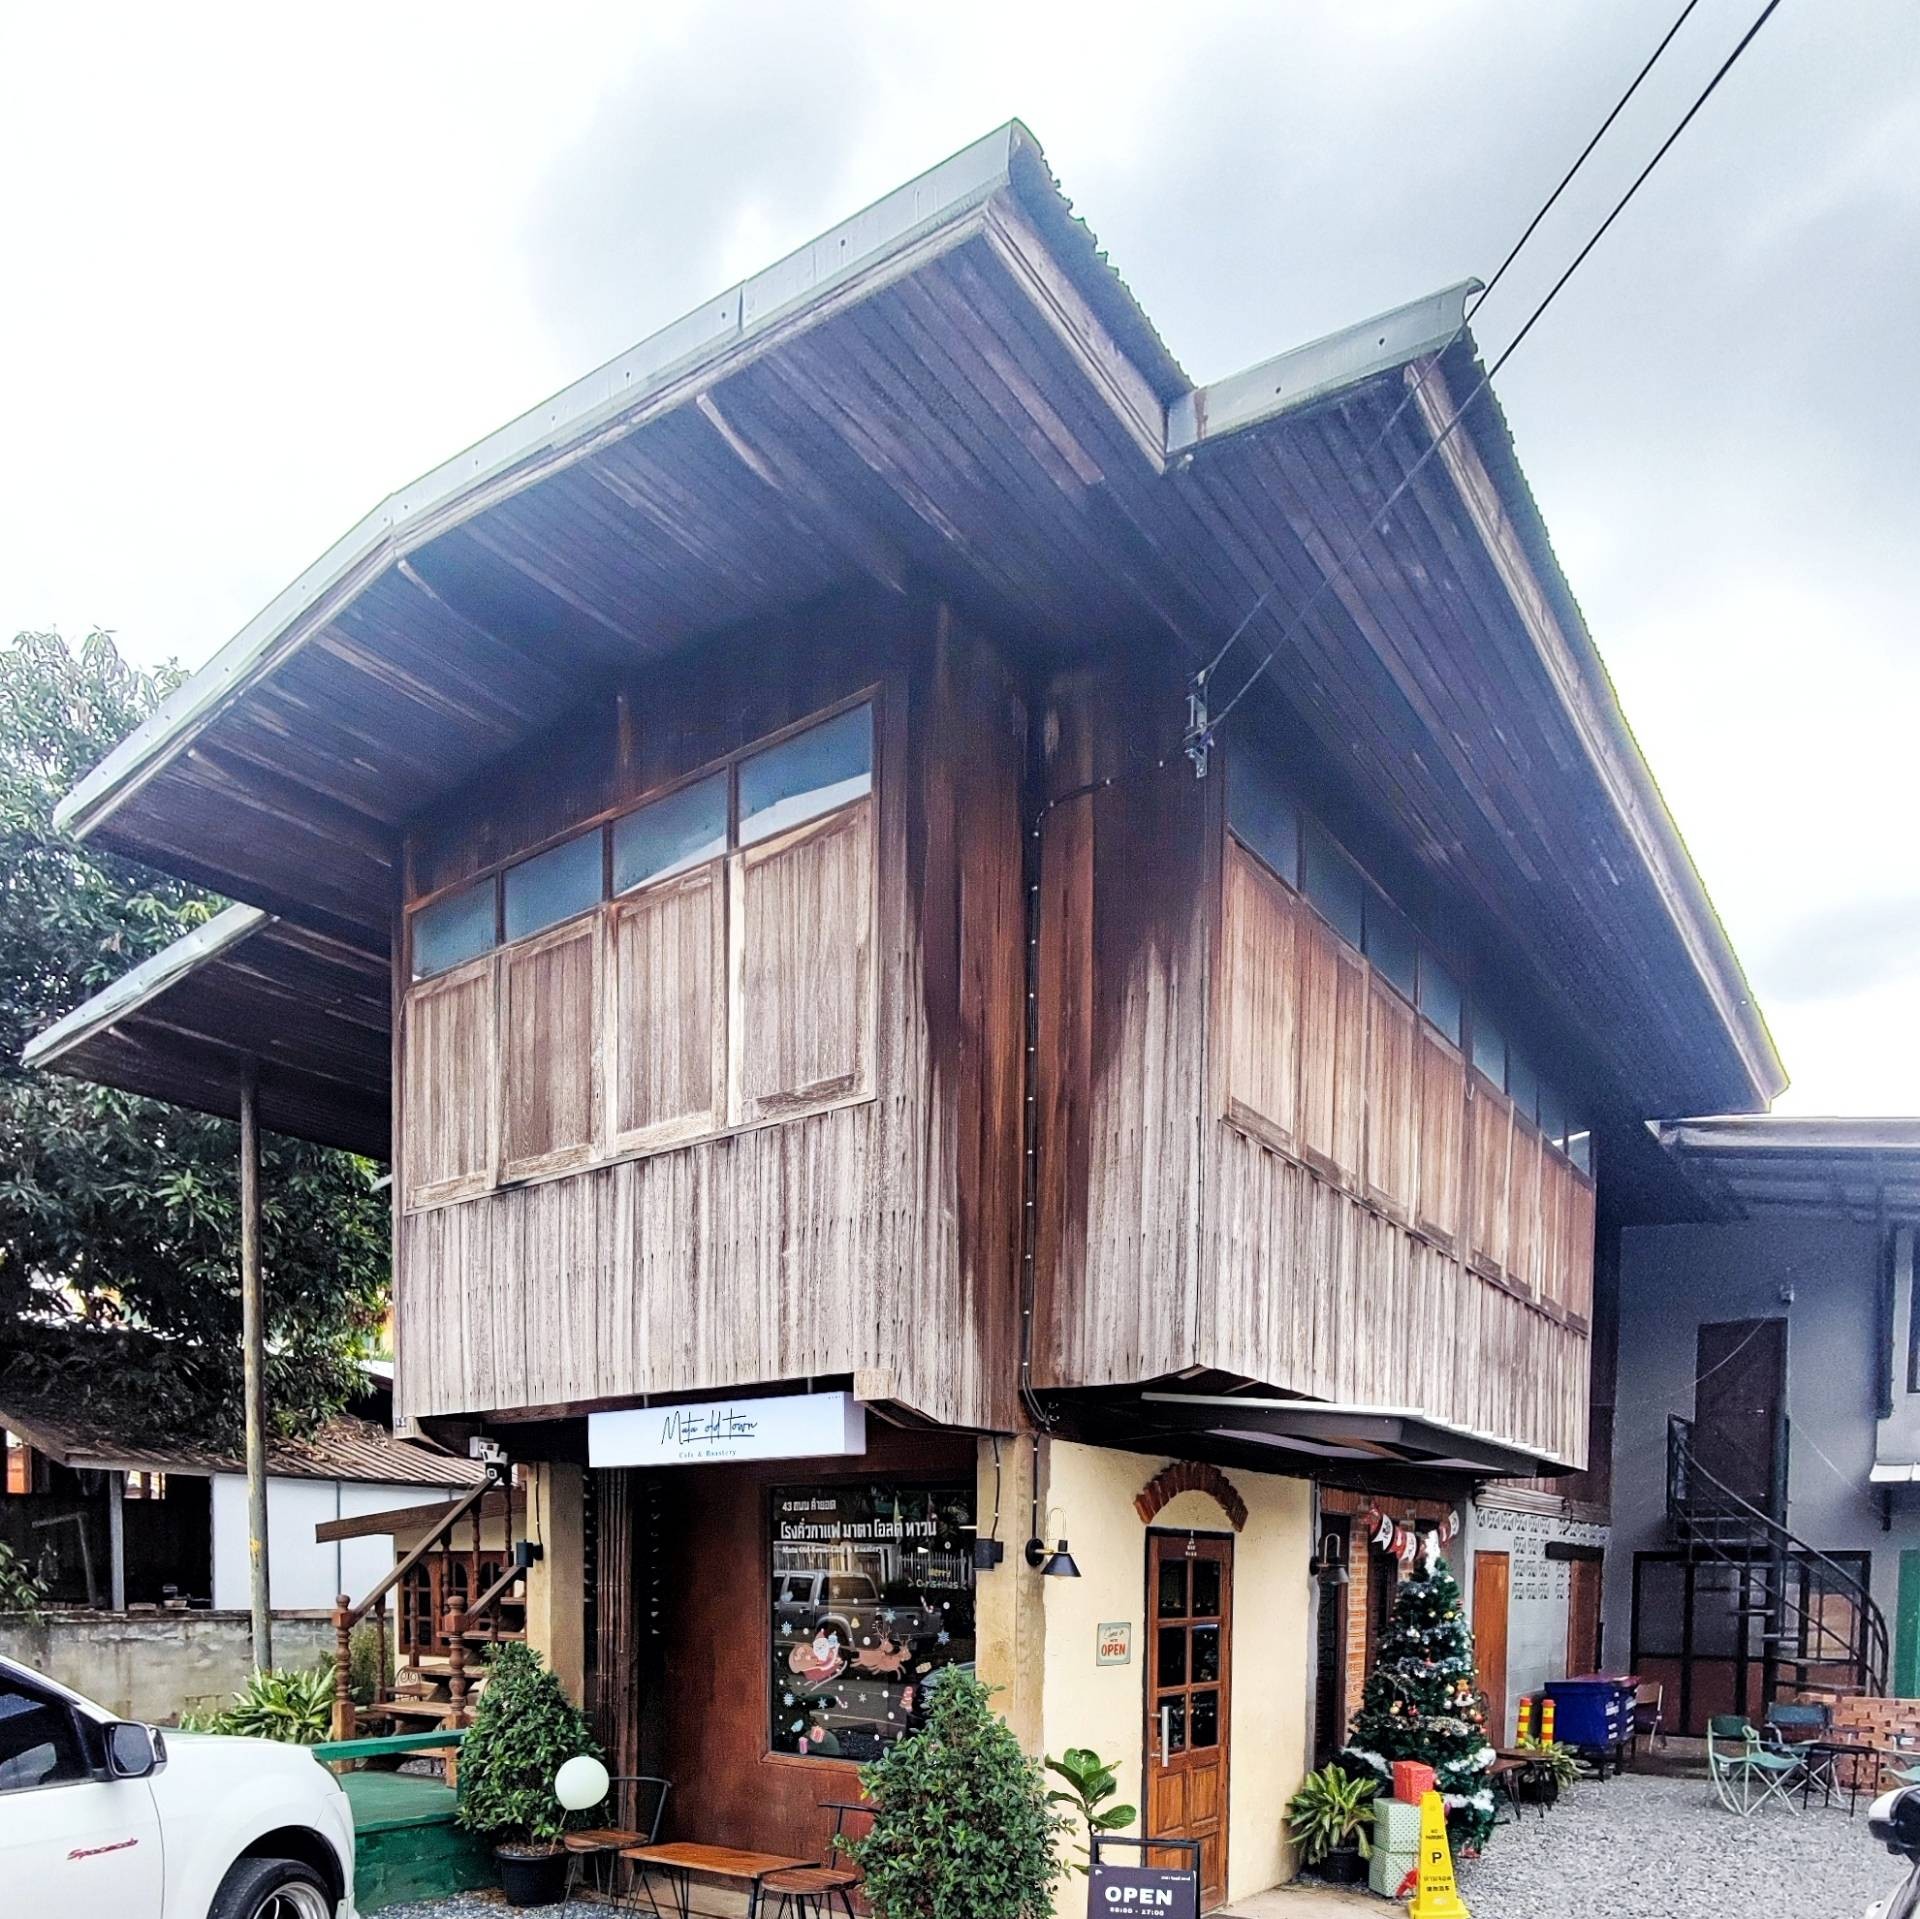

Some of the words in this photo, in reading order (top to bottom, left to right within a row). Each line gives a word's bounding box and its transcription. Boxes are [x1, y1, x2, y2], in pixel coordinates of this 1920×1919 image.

[661, 1410, 705, 1445] Mata
[704, 1409, 721, 1444] old
[706, 1449, 737, 1457] Roastery
[782, 1501, 792, 1512] 43
[780, 1517, 841, 1540] โรงคั่วกาแฟ
[842, 1522, 872, 1538] มาตา
[1101, 1643, 1126, 1657] OPEN
[1432, 1852, 1442, 1863] P
[1105, 1886, 1173, 1906] OPEN
